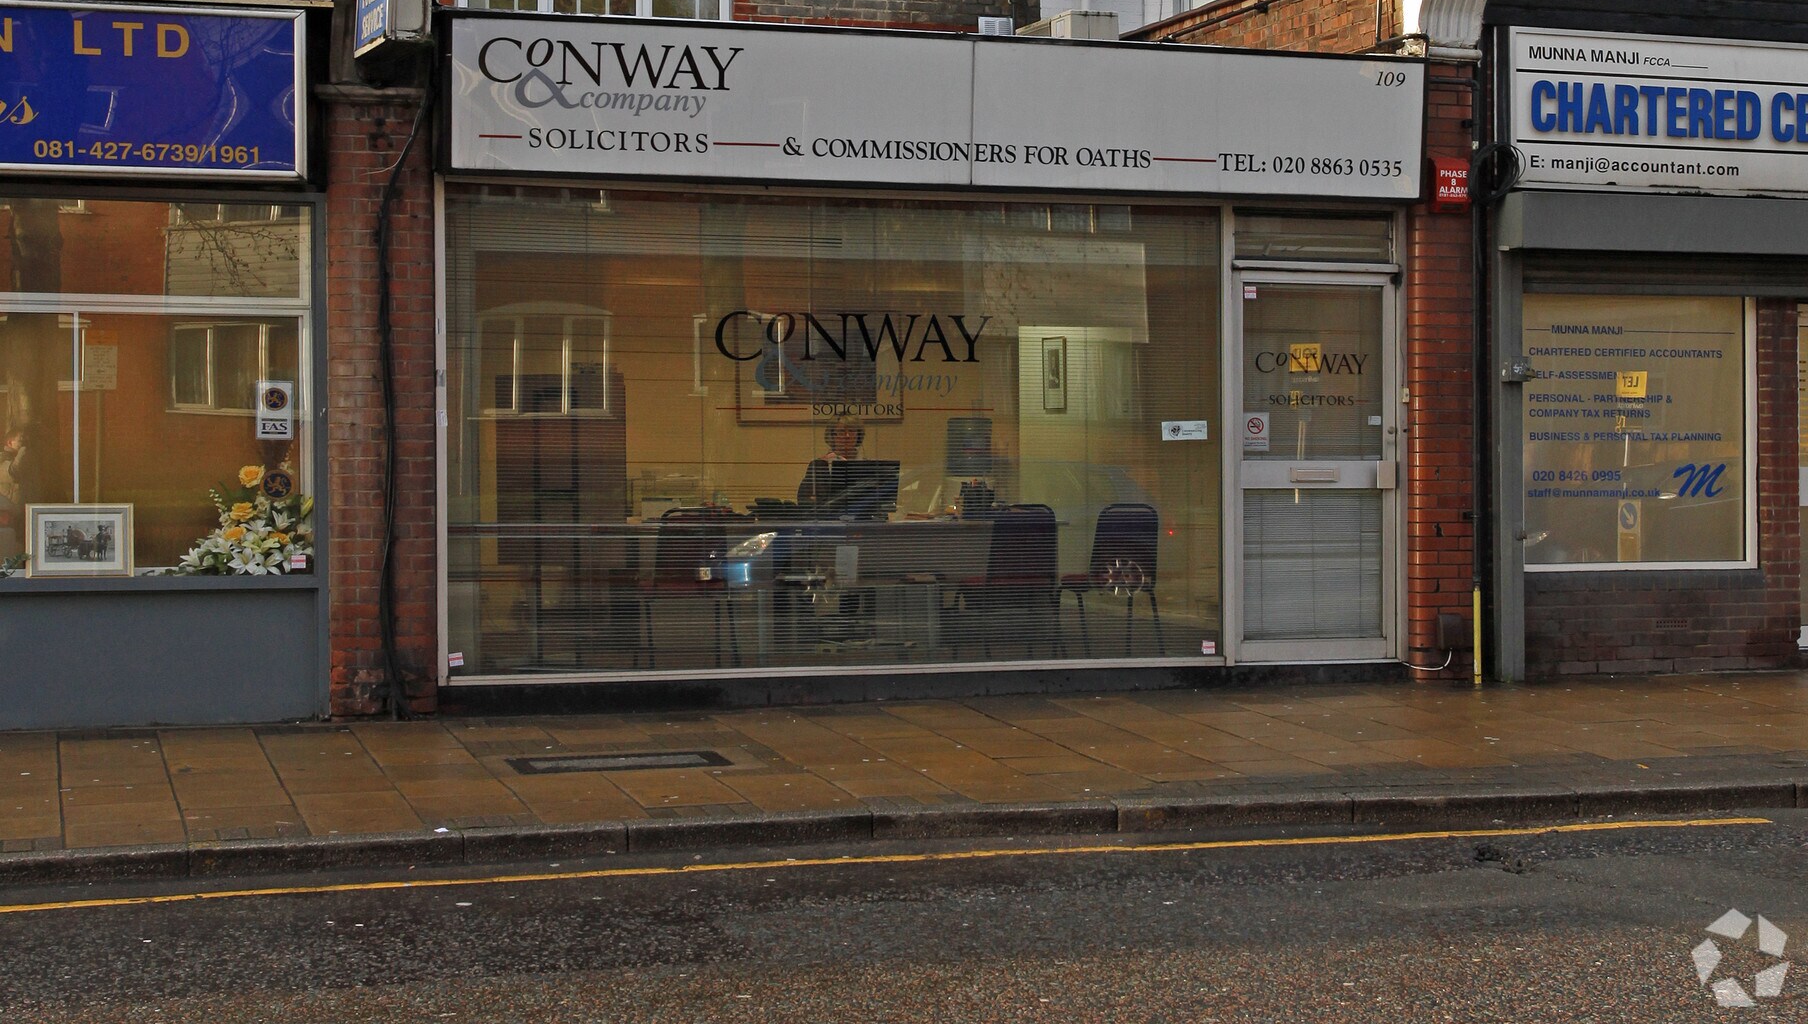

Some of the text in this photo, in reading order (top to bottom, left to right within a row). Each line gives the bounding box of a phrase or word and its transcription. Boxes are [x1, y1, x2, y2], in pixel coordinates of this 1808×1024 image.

[73, 19, 190, 59] LTD
[1528, 46, 1671, 67] MUNNA MANJI FCCA
[1375, 70, 1406, 88] 109
[515, 67, 707, 118] & company
[1530, 79, 1762, 141] CHARTERED
[528, 127, 709, 154] SOLICITORS
[33, 139, 261, 165] 081-427-6739/1961
[782, 136, 1402, 178] & COMMISSIONERS FOR OATHS TEL: 020 8863 0535
[1531, 155, 1740, 177] E: manji@accountant.com
[1440, 170, 1467, 178] PHASE
[1439, 186, 1468, 194] ALARM
[1551, 324, 1623, 335] MUNNA MANJI
[1528, 347, 1723, 359] CHARTERED CERTIFIED ACCOUNTANTS
[1269, 394, 1354, 406] SOLICITORS
[1528, 393, 1584, 403] PERSONAL
[1593, 394, 1664, 404] PARTNERSHIP
[1666, 394, 1673, 404] &
[812, 403, 904, 416] SOLICITORS
[1528, 408, 1651, 419] COMPANY TAX RETURNS
[261, 423, 287, 431] FAS
[1529, 431, 1723, 442] BUSINESS & PERSONAL TAX PLANNING
[1532, 470, 1622, 482] 020 8426 0995
[1527, 487, 1661, 499] staff@munnamanji.co.uk
